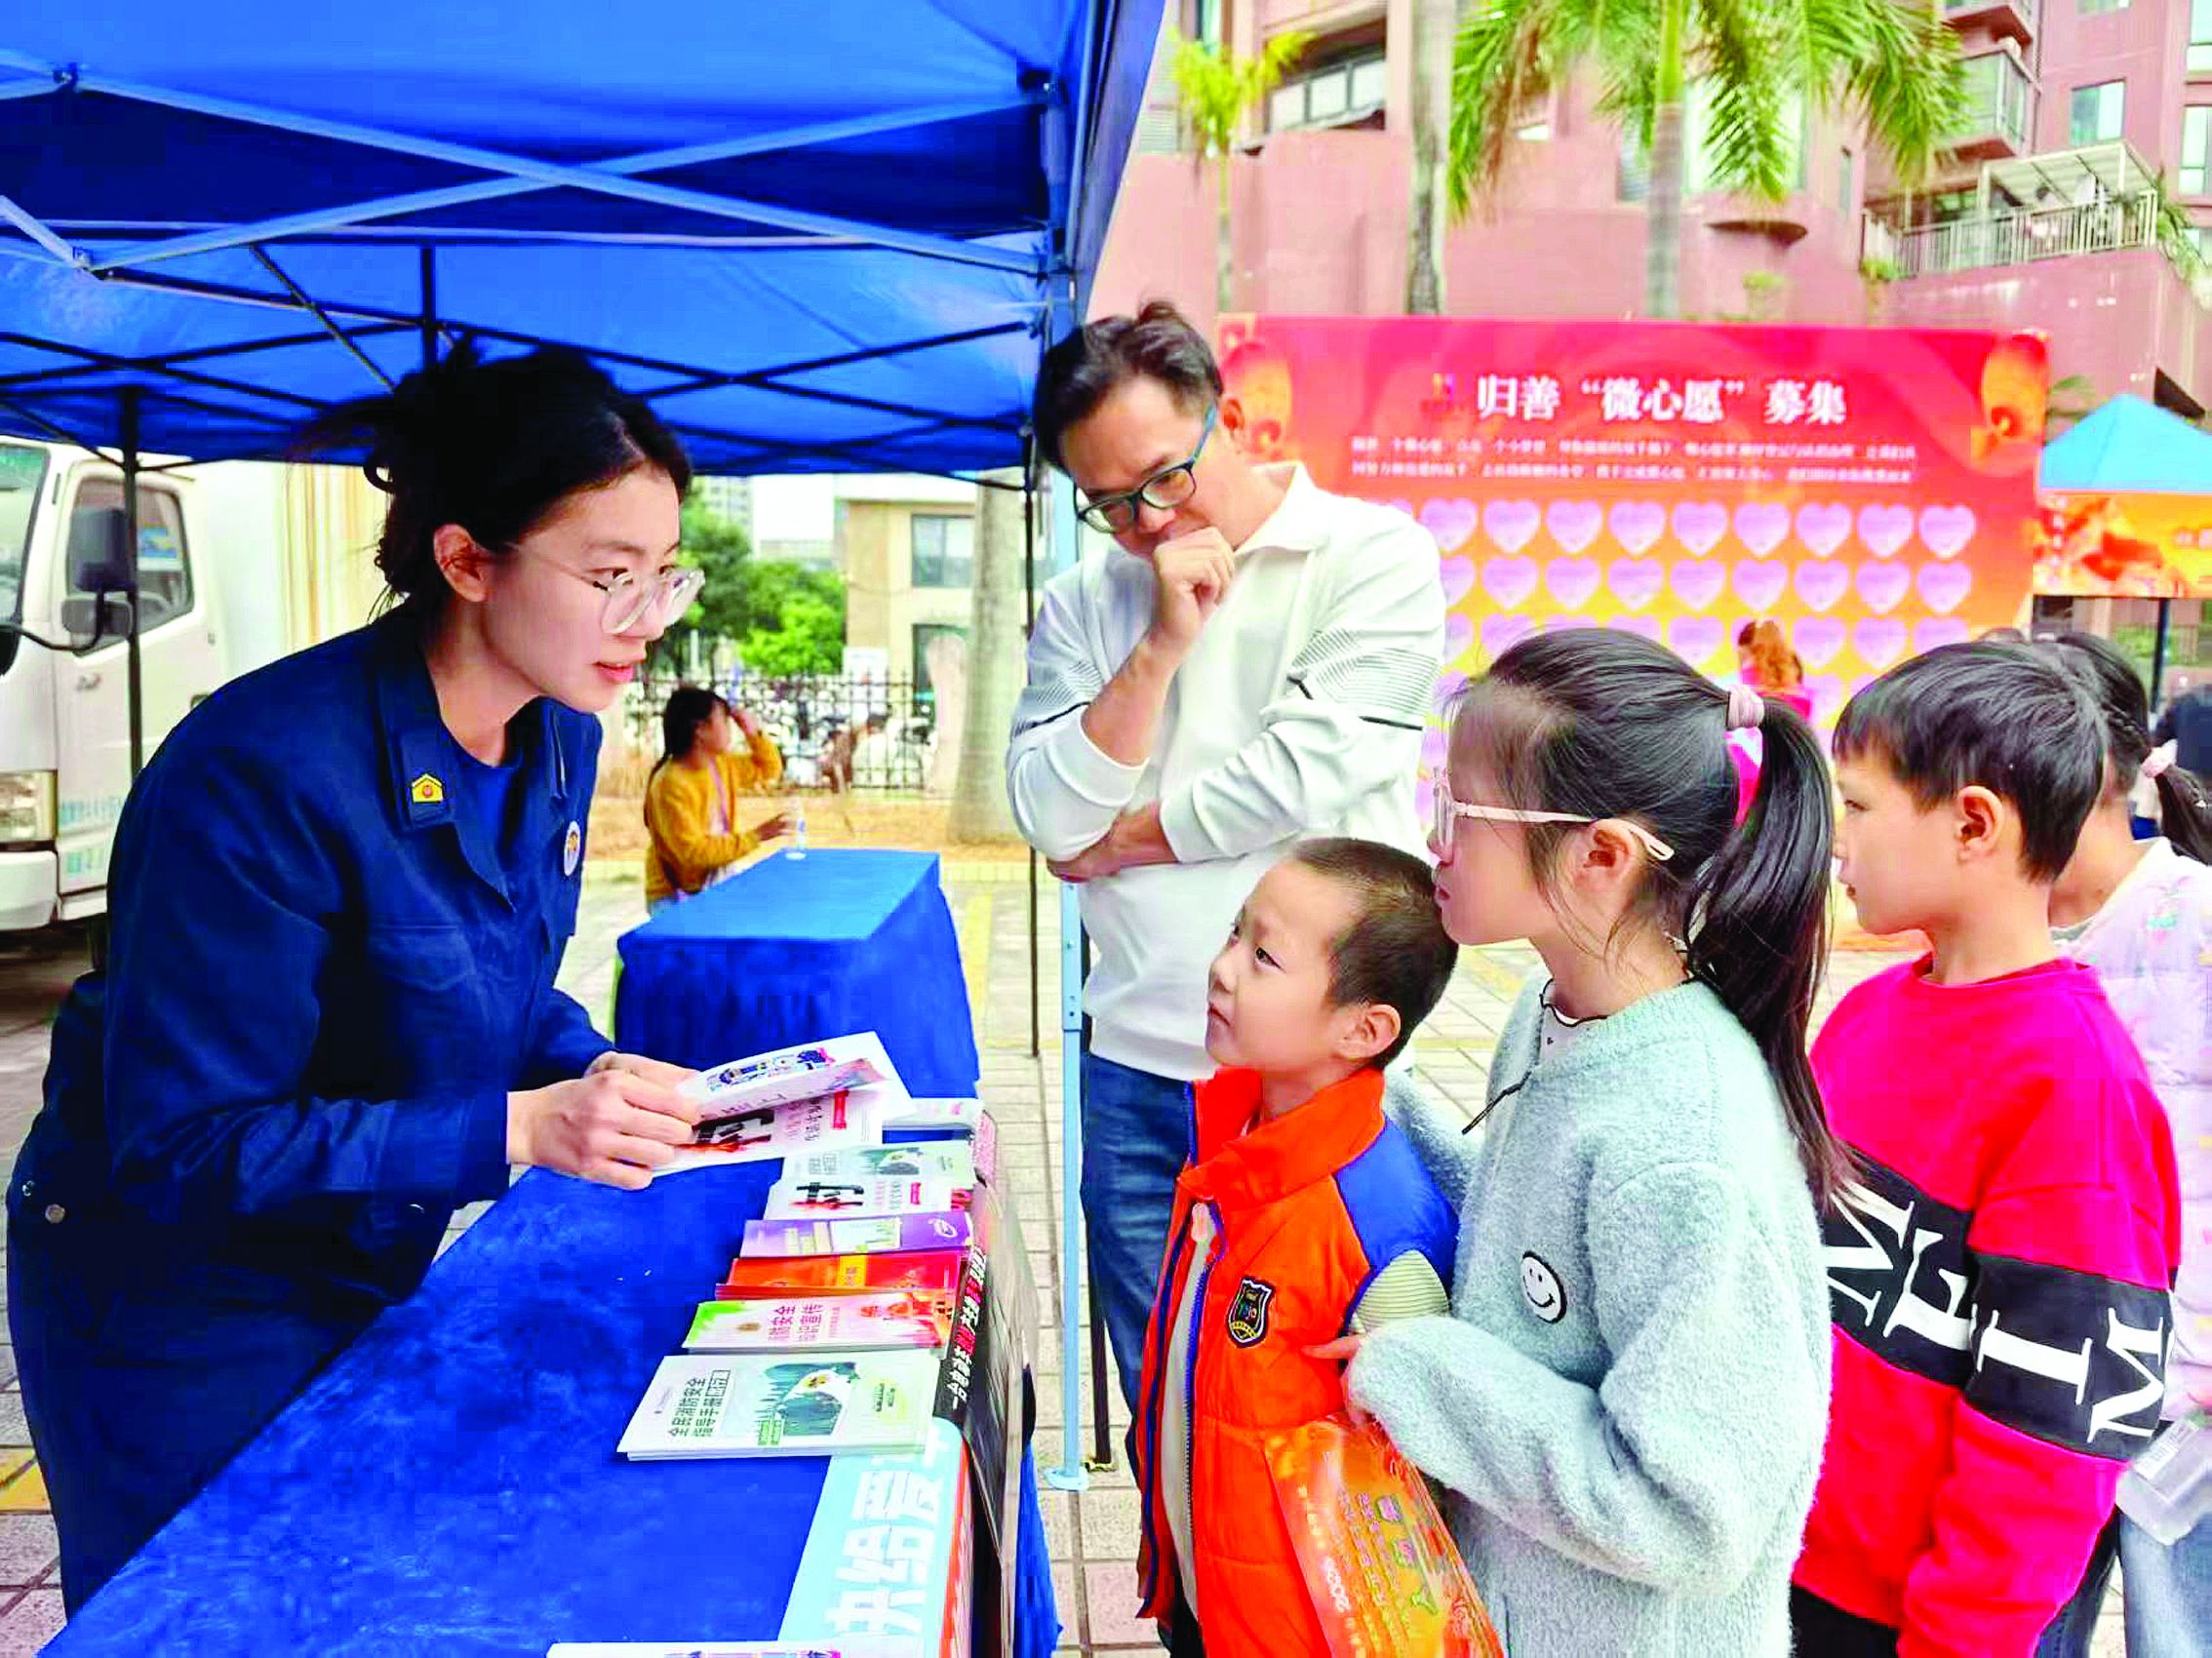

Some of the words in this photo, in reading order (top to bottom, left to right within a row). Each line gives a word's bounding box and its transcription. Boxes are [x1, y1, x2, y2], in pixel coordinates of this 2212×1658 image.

[667, 1376, 706, 1437] 全民消防安全
